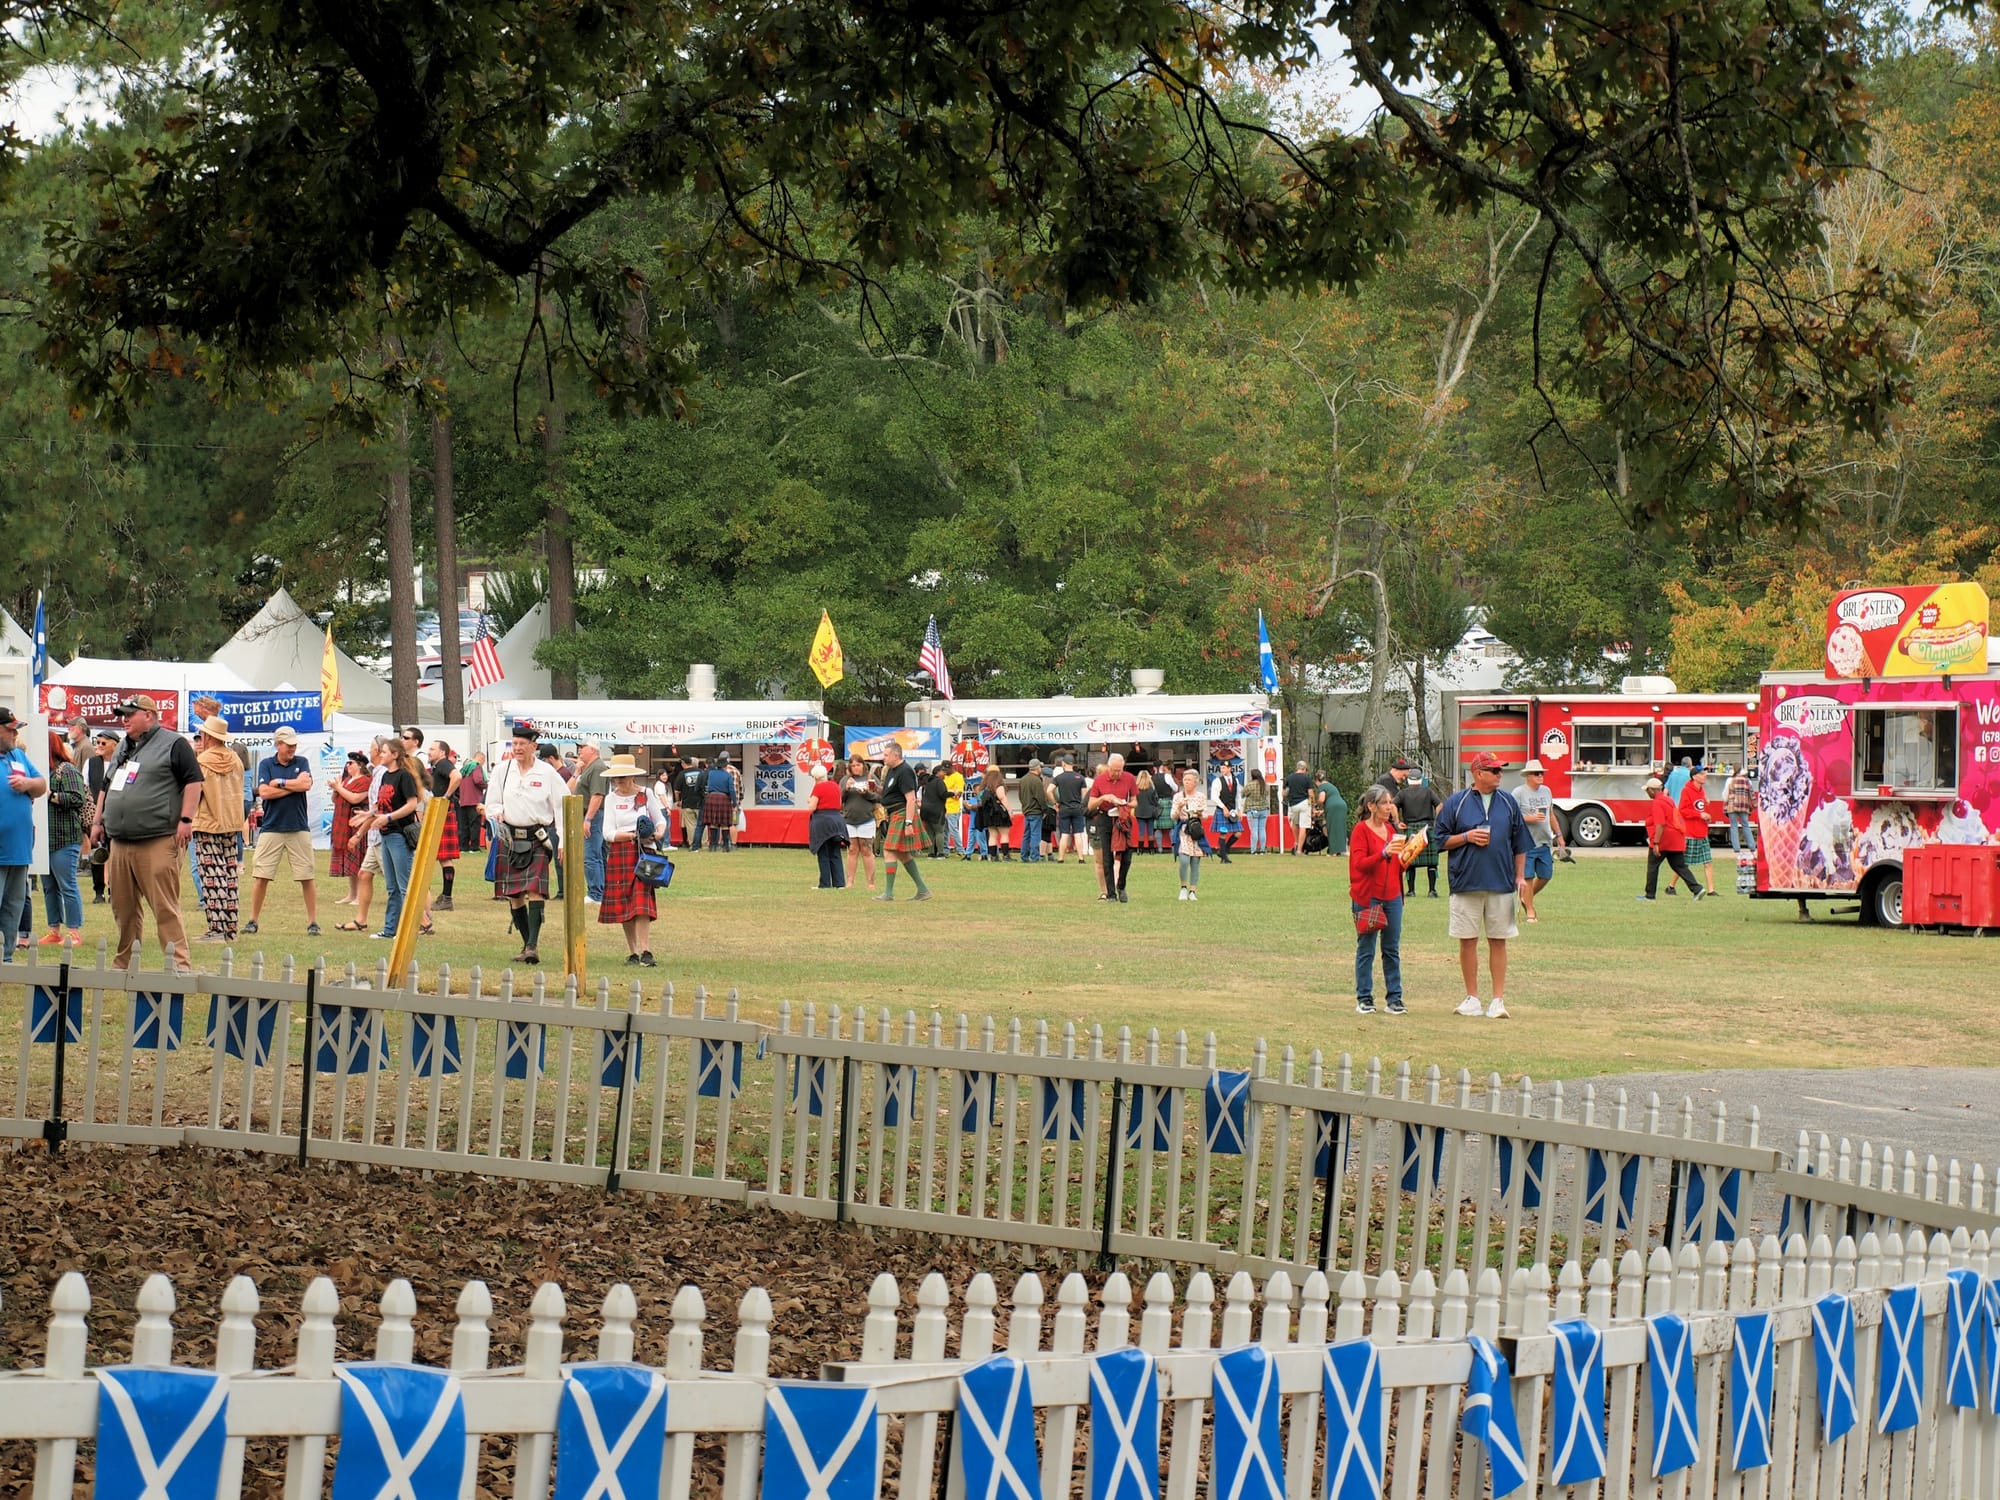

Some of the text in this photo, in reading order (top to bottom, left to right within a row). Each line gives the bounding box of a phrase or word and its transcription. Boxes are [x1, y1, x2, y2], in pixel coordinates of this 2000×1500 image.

[73, 693, 118, 705] SCONES
[223, 697, 320, 714] STICKY TOFFEE
[244, 711, 302, 726] PUDDING
[1204, 717, 1240, 726] BRIDIES
[558, 721, 578, 729] PIES
[746, 720, 783, 729] BRIDIES
[1021, 721, 1041, 730] PIES
[712, 731, 774, 740] FISH & CHIPS
[1002, 732, 1078, 740] SAUSAGE ROLLS
[1203, 727, 1231, 736] CHIPS
[756, 771, 793, 779] HAGGIS
[771, 781, 778, 789] &
[761, 792, 789, 800] CHIPS
